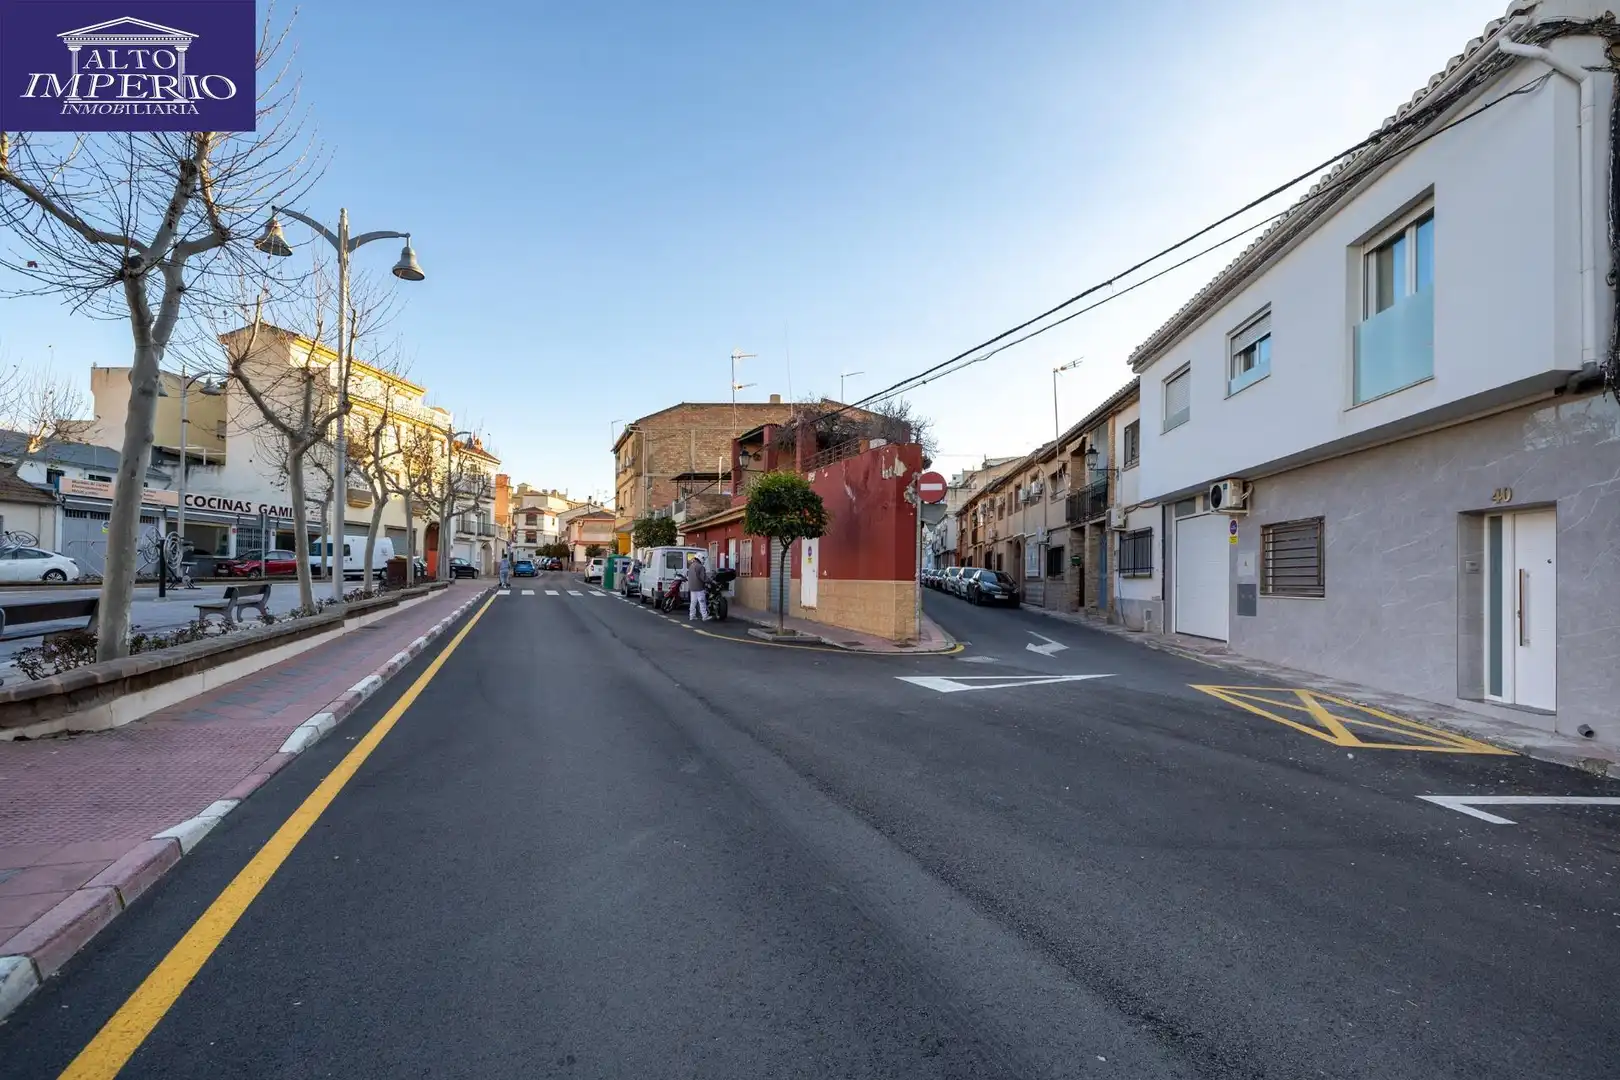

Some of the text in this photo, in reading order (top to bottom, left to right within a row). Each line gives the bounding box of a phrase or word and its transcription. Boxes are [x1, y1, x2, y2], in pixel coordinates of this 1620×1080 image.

[1491, 487, 1513, 504] 40
[184, 494, 252, 513] COCINAS
[258, 504, 296, 518] GAMI
